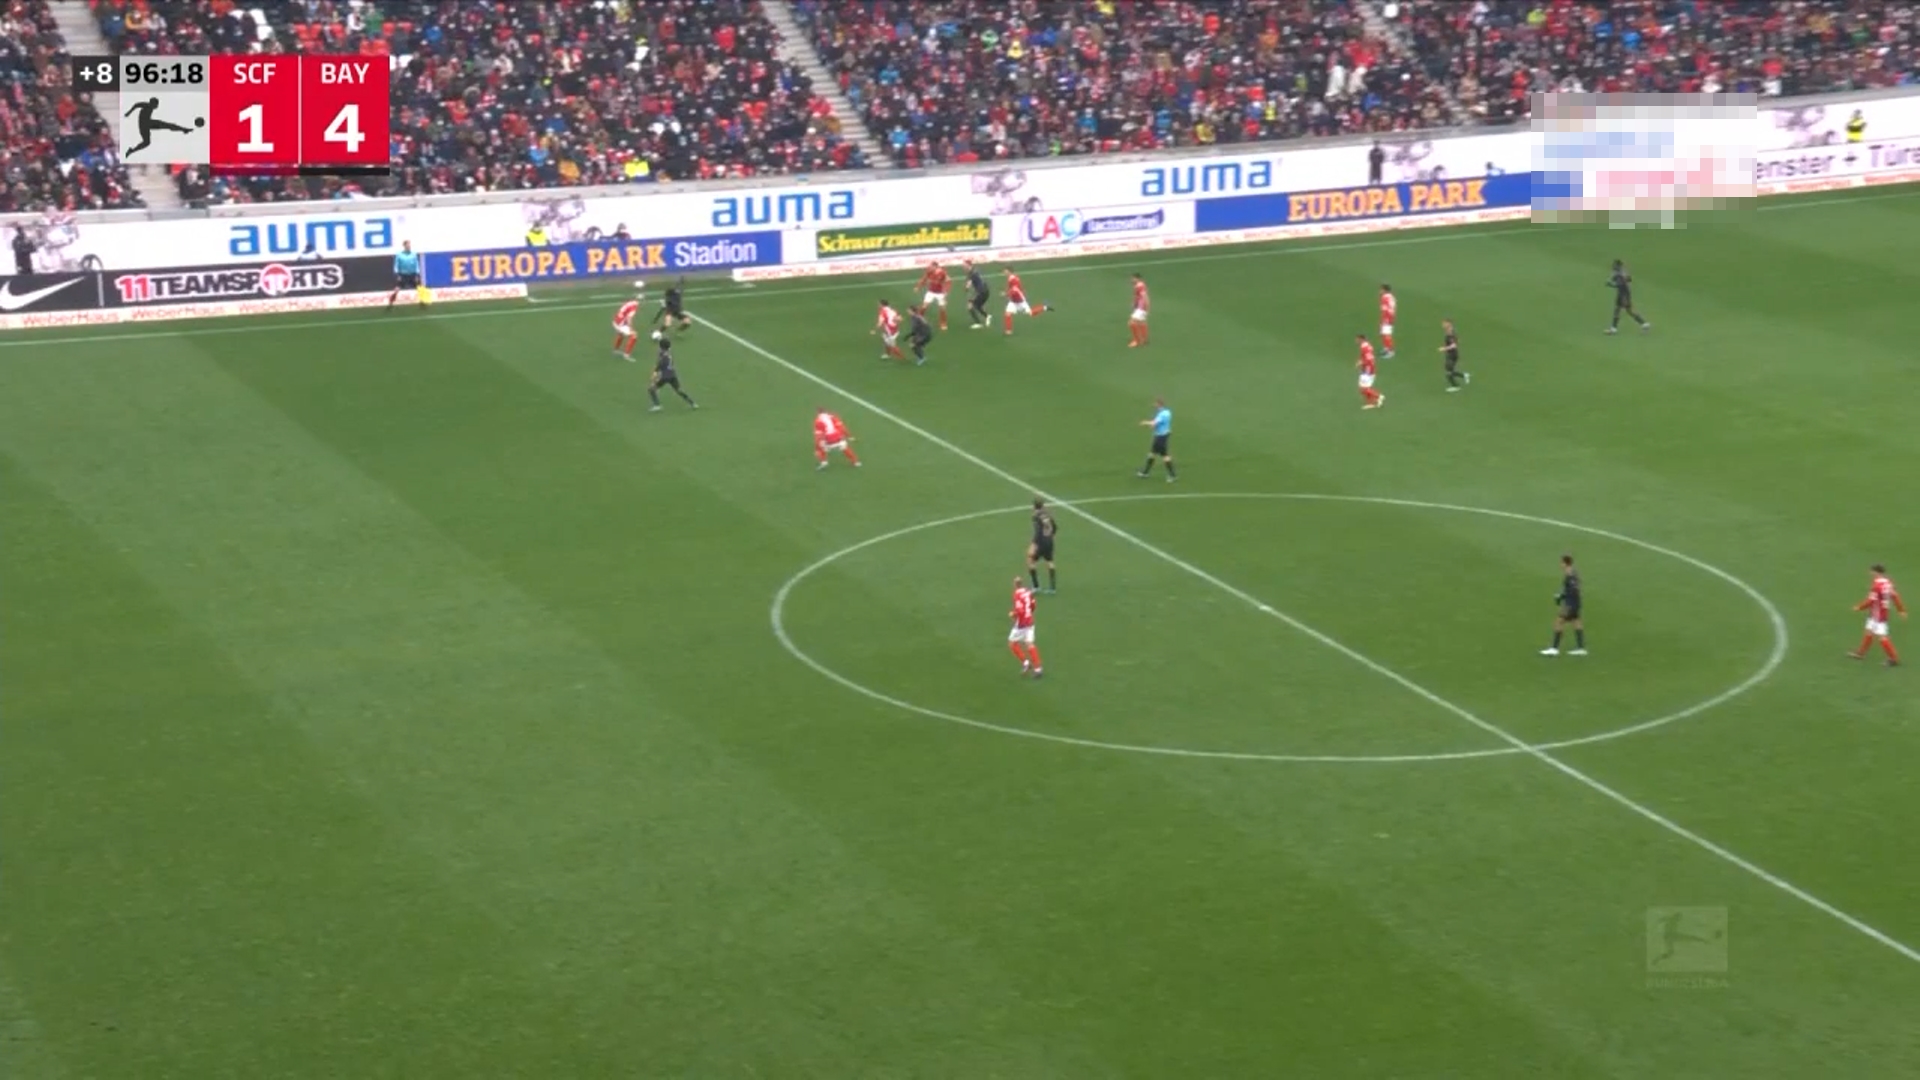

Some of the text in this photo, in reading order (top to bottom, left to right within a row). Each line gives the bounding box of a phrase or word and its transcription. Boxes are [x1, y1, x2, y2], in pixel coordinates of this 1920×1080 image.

[1141, 160, 1272, 197] auma
[1757, 154, 1835, 180] enster
[712, 189, 855, 228] auma
[1287, 178, 1488, 222] EUROPA PARK
[230, 218, 393, 256] auma
[818, 224, 990, 253] Schwarzwaldmilch
[1028, 212, 1075, 242] LAC
[452, 239, 757, 282] EUROPA PARK Stadion
